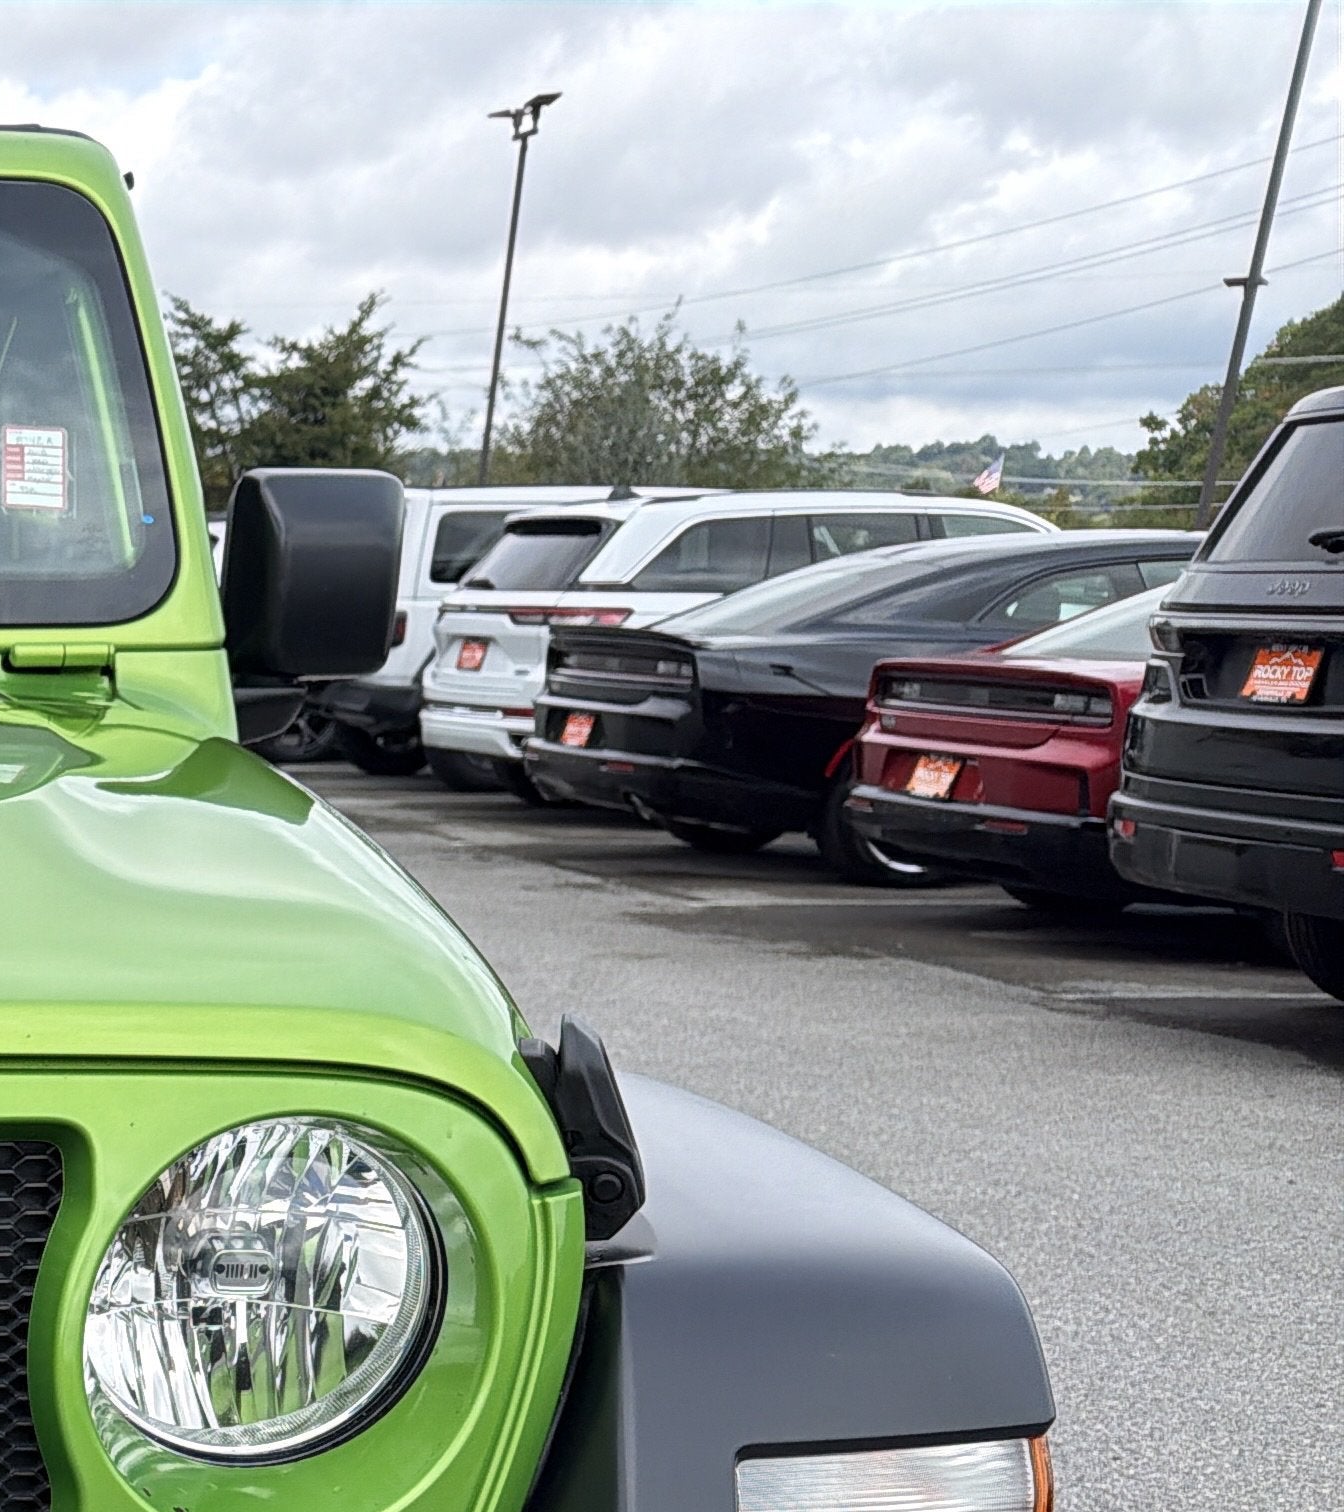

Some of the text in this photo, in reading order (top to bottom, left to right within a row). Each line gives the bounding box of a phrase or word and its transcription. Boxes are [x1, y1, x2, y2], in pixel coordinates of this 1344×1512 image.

[1267, 580, 1310, 599] Jeep
[1253, 664, 1314, 681] ROCKY TOP
